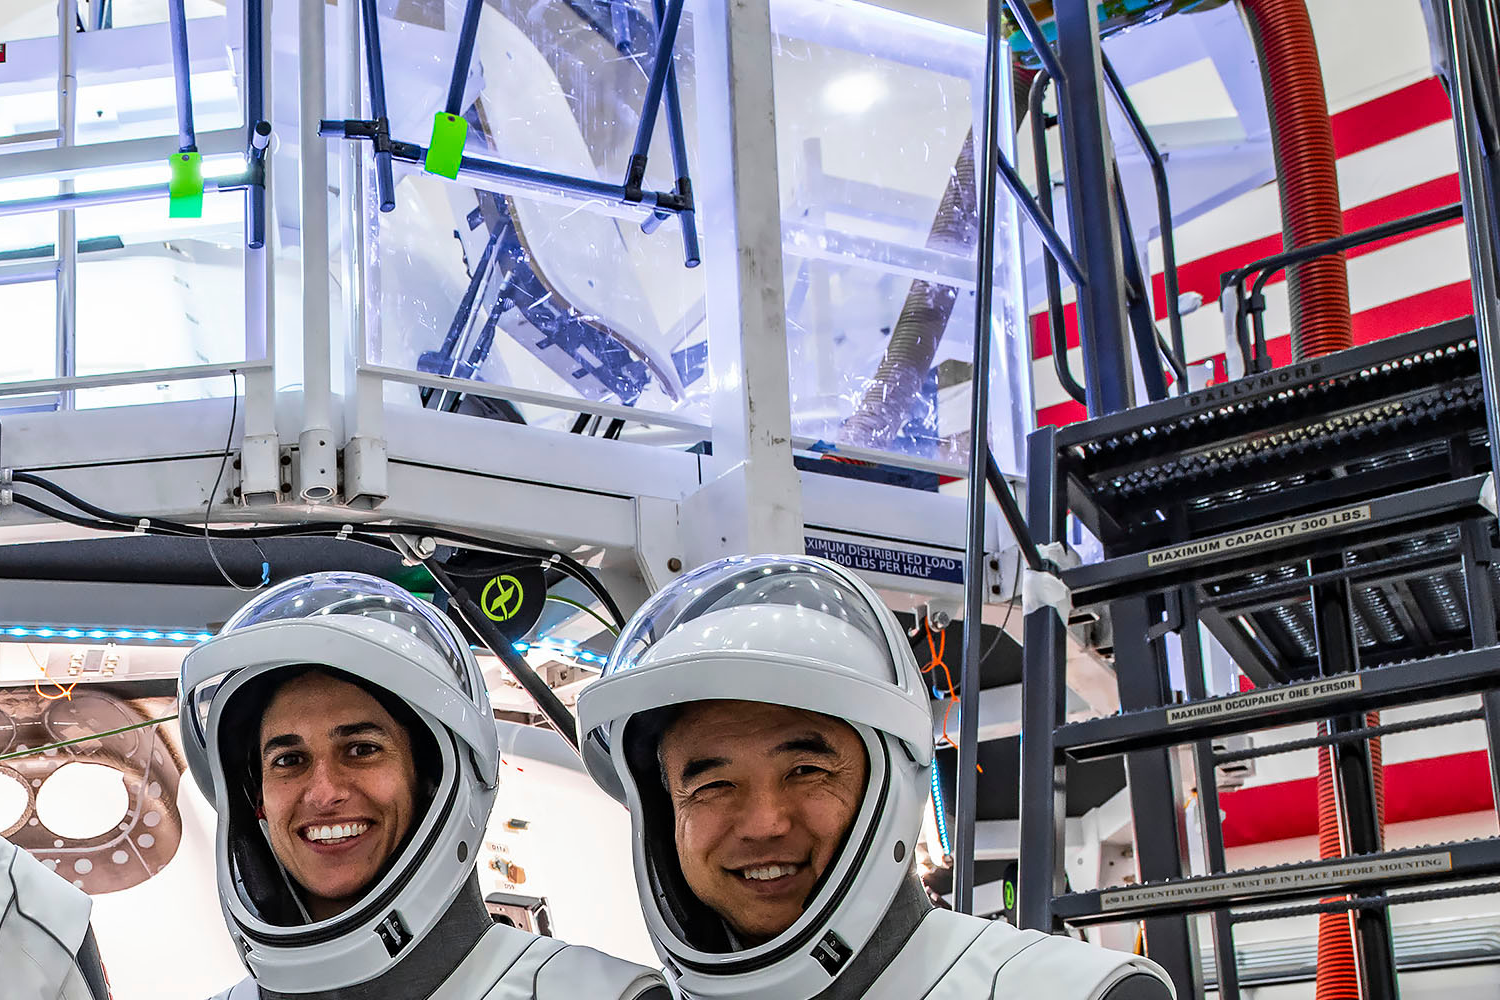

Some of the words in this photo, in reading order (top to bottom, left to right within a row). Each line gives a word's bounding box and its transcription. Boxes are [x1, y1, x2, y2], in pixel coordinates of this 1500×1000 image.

[1188, 363, 1322, 406] BALLYMORE
[848, 544, 924, 565] DISTRIBUTED
[925, 555, 956, 570] LOAD
[1151, 540, 1221, 563] MAXIMUM
[1225, 524, 1296, 548] CAPACITY
[1301, 517, 1328, 531] 300
[1333, 509, 1366, 524] LBS.
[823, 551, 852, 566] 1500
[854, 555, 877, 570] LBS
[879, 559, 901, 574] PER
[903, 564, 932, 577] HALF
[1171, 703, 1223, 721] MAXIMUM
[1225, 692, 1285, 711] OCCUPANCY
[1288, 686, 1311, 699] ONE
[1313, 679, 1356, 695] PERSON
[1121, 894, 1135, 903] LB
[1232, 880, 1261, 890] MUST
[1264, 877, 1278, 886] BE
[1280, 875, 1293, 883] IN
[1294, 871, 1329, 882] PLACE
[1332, 865, 1377, 878] BEFORE
[1378, 858, 1443, 874] MOUNTING
